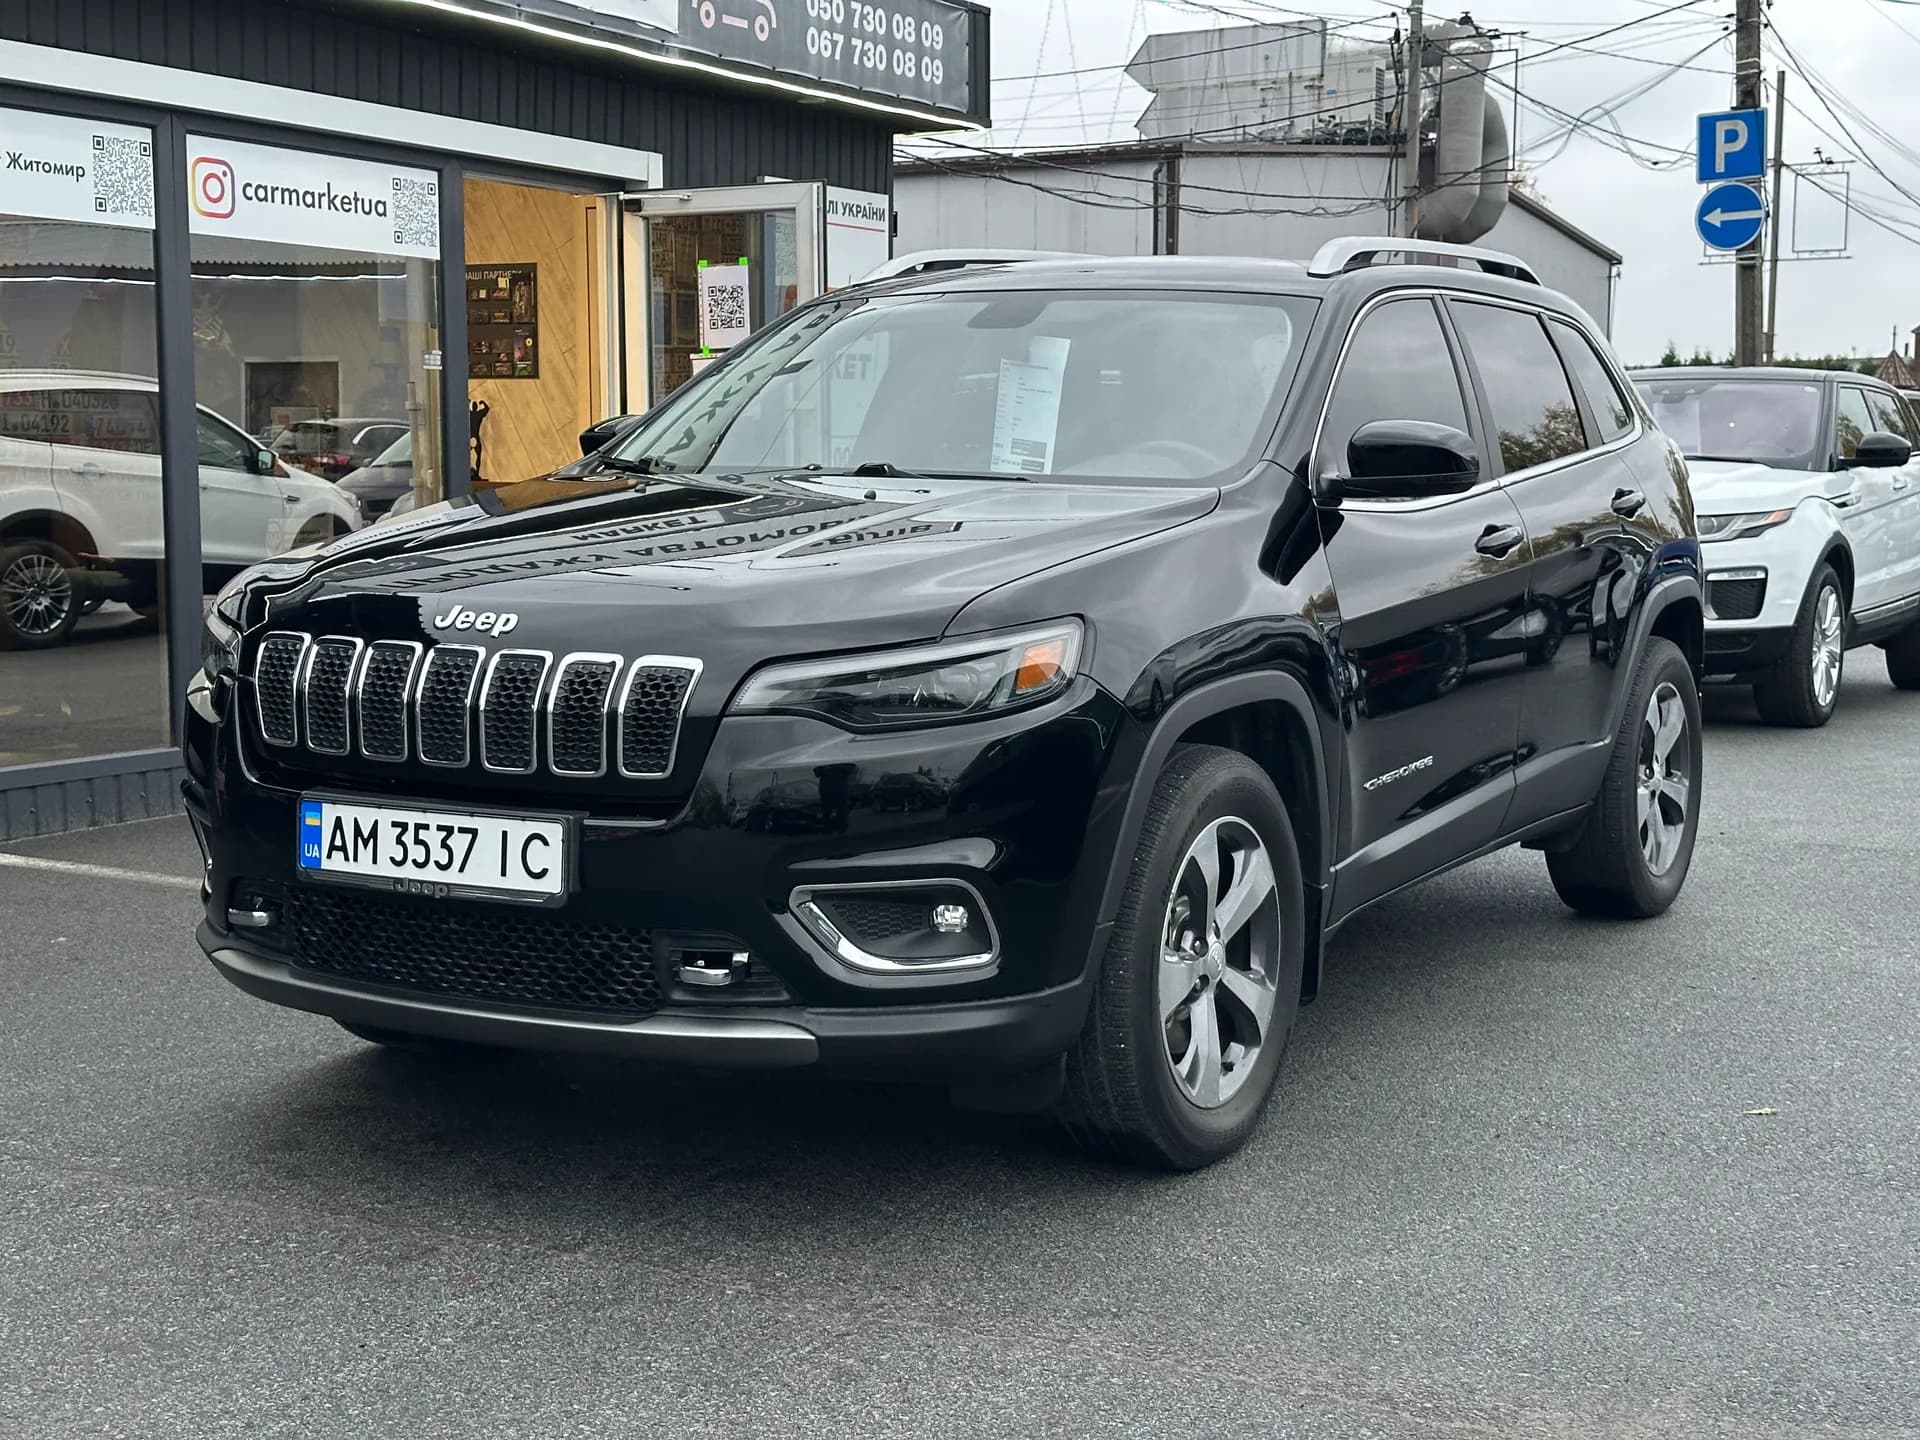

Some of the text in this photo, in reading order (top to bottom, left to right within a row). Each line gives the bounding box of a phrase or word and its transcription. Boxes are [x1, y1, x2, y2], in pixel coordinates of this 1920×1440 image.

[806, 0, 944, 50] 050 730 08 09
[806, 27, 944, 85] 067 730 08 09
[1715, 120, 1748, 173] P
[6, 151, 86, 182] Житомир
[242, 182, 388, 217] carmarketua
[841, 202, 886, 222] УКРАЇНИ
[433, 604, 519, 638] Jeep
[1363, 755, 1433, 791] CHEROKEE
[304, 842, 320, 858] UA
[326, 815, 550, 880] AM 3537 IC
[393, 876, 448, 899] Jeep
